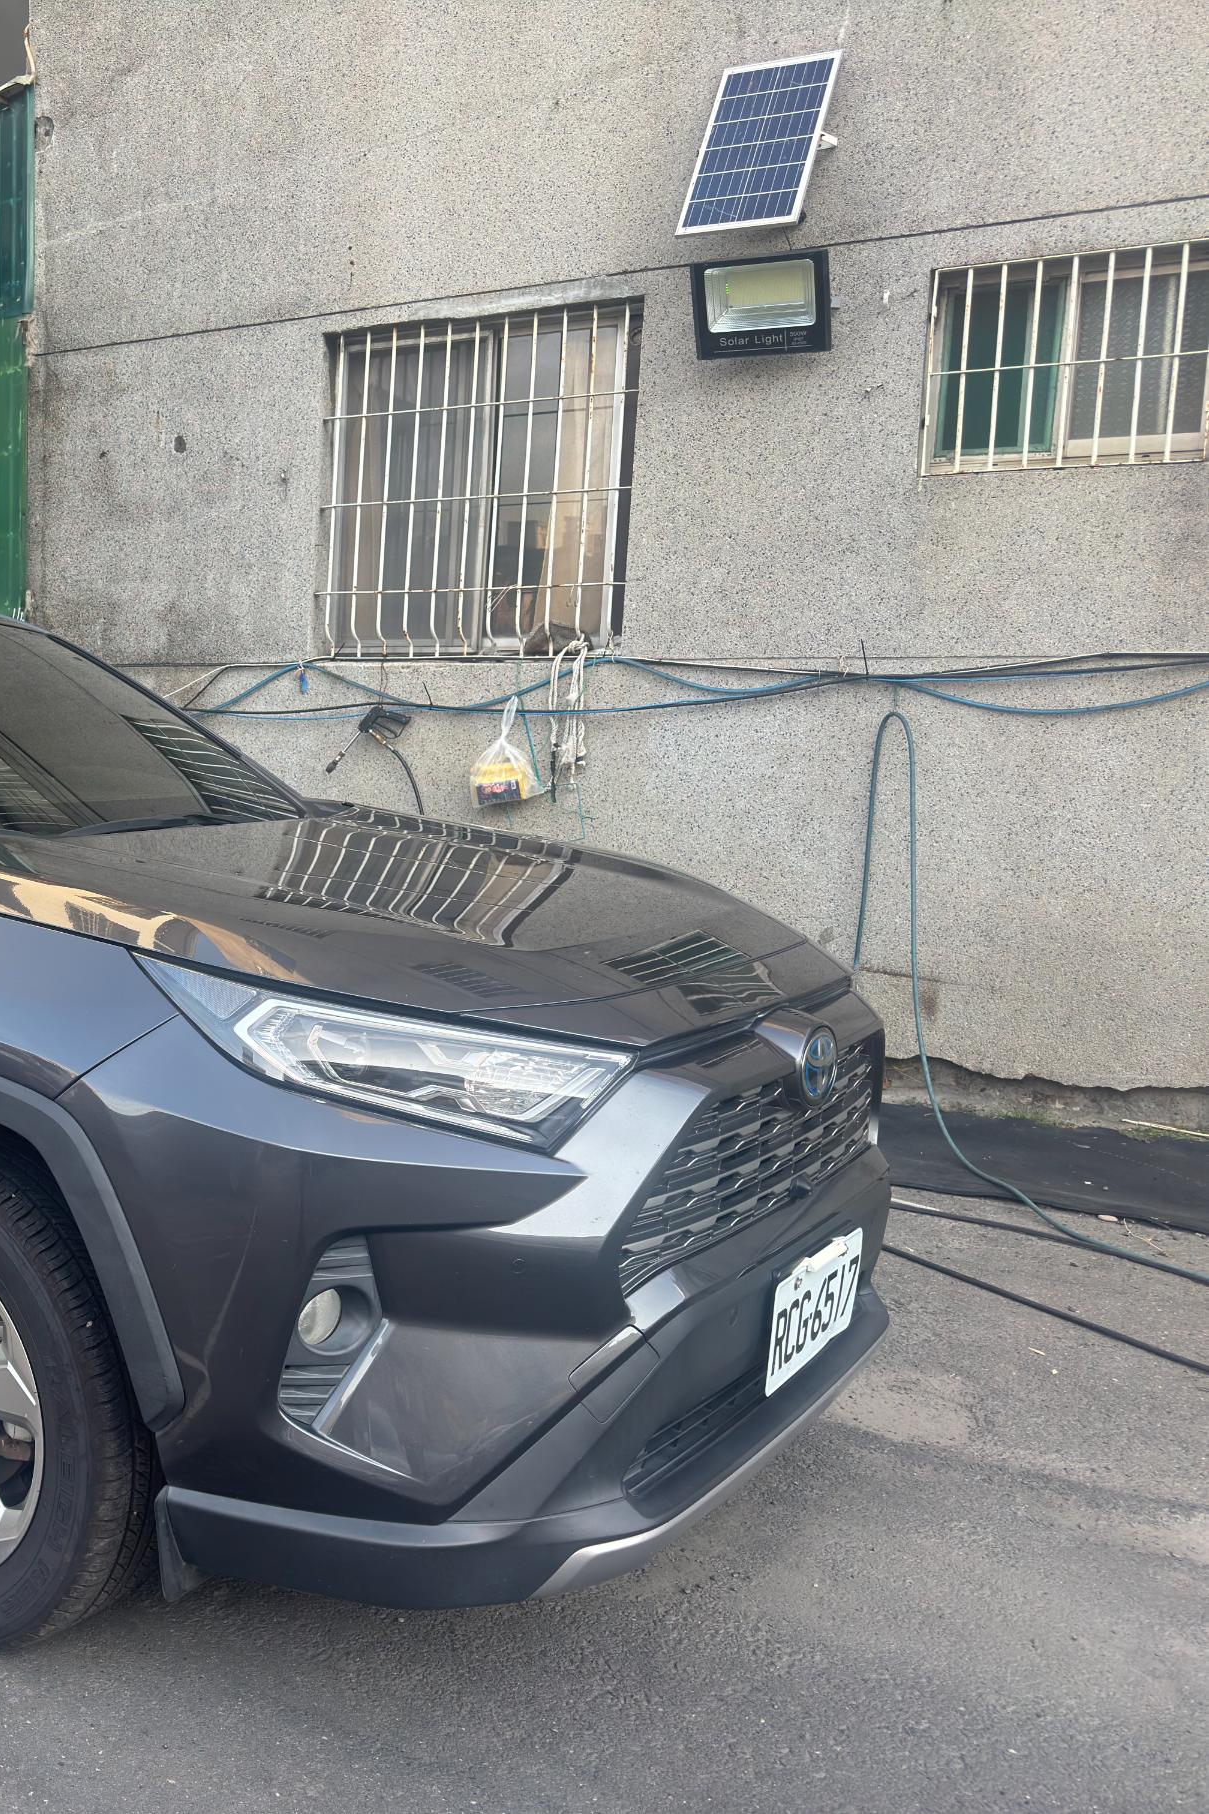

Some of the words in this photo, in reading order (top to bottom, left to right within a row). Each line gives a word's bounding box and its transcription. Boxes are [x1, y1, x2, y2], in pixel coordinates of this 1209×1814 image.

[719, 335, 749, 347] Solar
[755, 333, 783, 348] Light
[770, 1253, 860, 1377] RCG-6517
